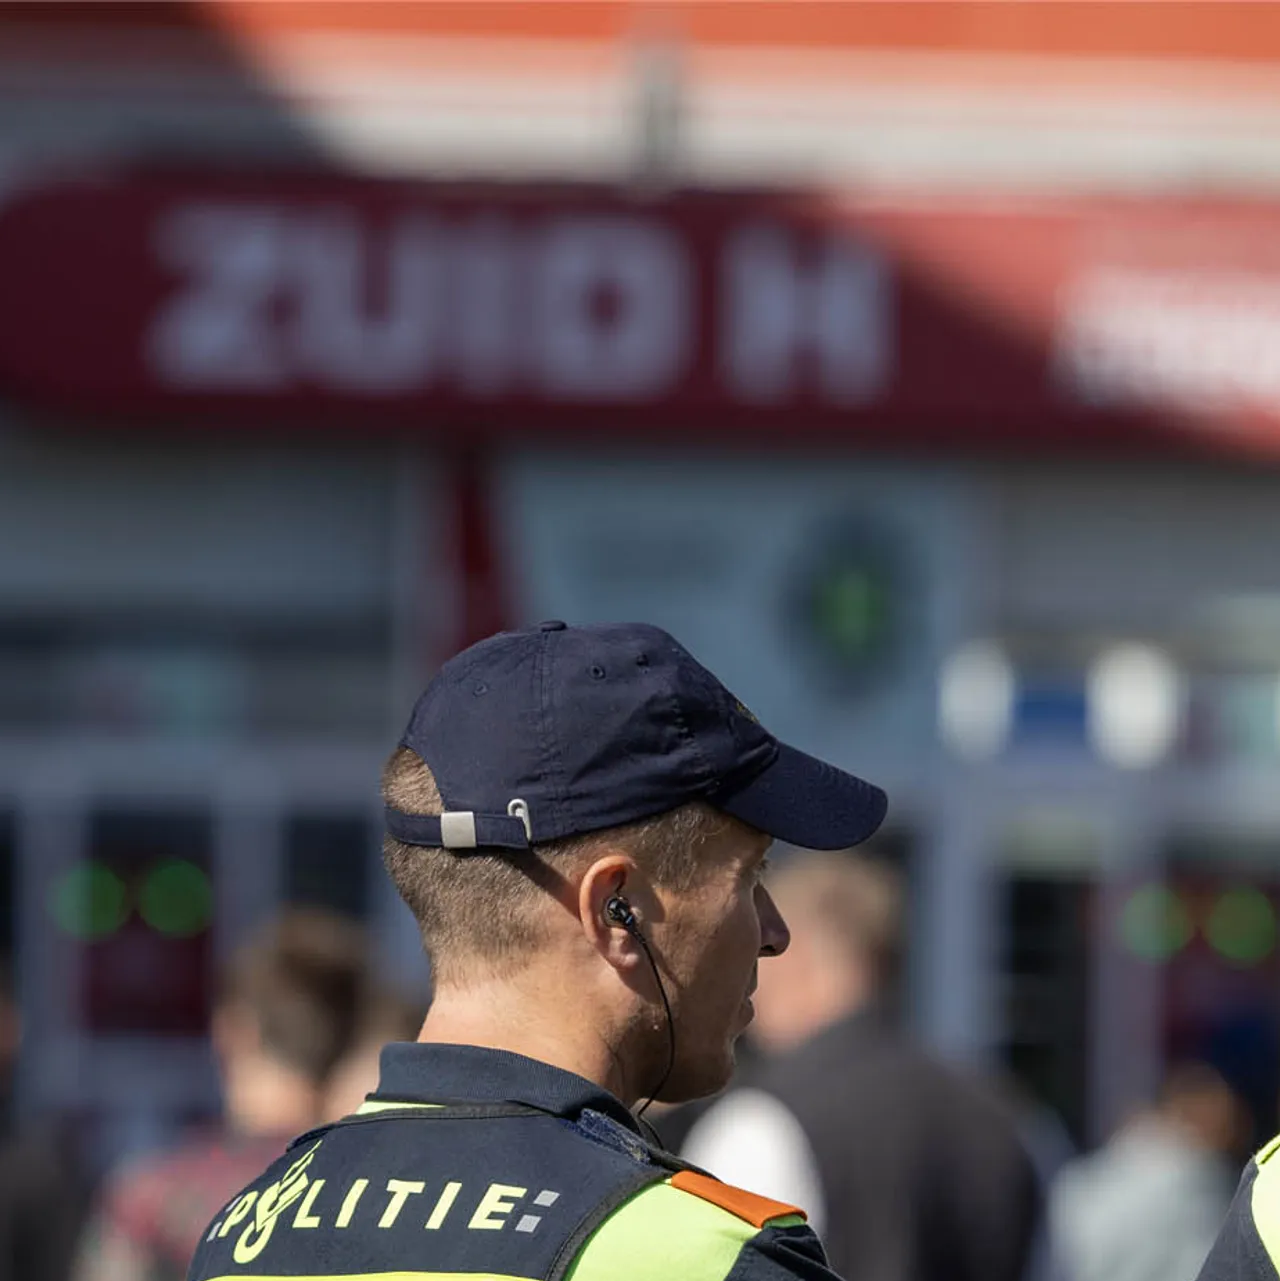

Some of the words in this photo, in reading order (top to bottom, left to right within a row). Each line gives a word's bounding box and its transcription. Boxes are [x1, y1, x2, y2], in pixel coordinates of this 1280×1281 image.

[150, 206, 694, 396] ZUID
[724, 216, 890, 404] H
[218, 1140, 527, 1264] POLITIE
